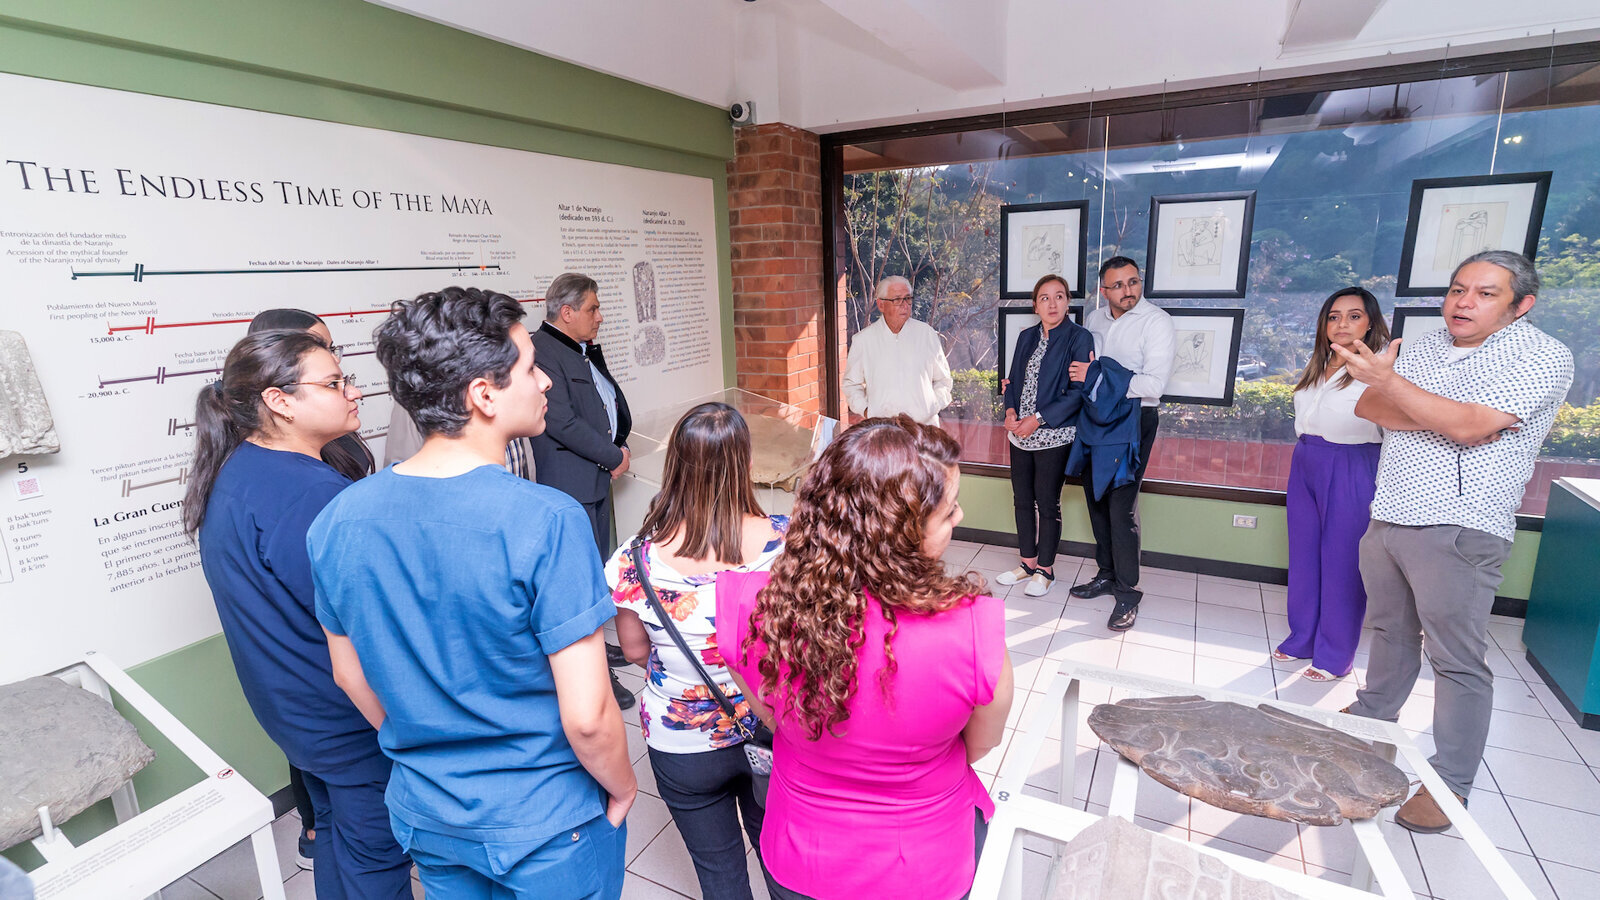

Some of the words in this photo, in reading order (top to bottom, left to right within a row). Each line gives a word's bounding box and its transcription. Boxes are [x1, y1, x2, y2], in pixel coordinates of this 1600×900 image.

[6, 159, 100, 194] THE
[115, 168, 264, 204] ENDLESS
[273, 181, 344, 208] TIME
[441, 194, 493, 216] MAYA
[583, 206, 602, 214] Naranjo
[70, 249, 100, 258] mythical
[66, 312, 98, 320] peopling
[88, 390, 112, 399] 20,900
[18, 462, 29, 474] 5
[90, 466, 112, 475] Tercer
[114, 462, 136, 472] piktun
[138, 457, 162, 466] anterior
[100, 473, 117, 482] Third
[119, 470, 139, 480] piktun
[141, 466, 161, 474] before
[93, 517, 110, 527] La
[114, 508, 148, 522] Gran
[151, 500, 184, 513] Cuen
[113, 529, 147, 541] algunas
[149, 519, 184, 532] inscripc
[20, 534, 42, 542] tunes
[101, 548, 120, 558] que
[115, 552, 151, 568] primero
[107, 568, 134, 581] 7,885
[137, 562, 160, 573] años.
[162, 557, 172, 565] La
[175, 550, 200, 562] prime
[110, 577, 145, 593] anterior
[166, 564, 188, 576] fecha
[190, 560, 202, 568] ba
[998, 791, 1010, 801] 8
